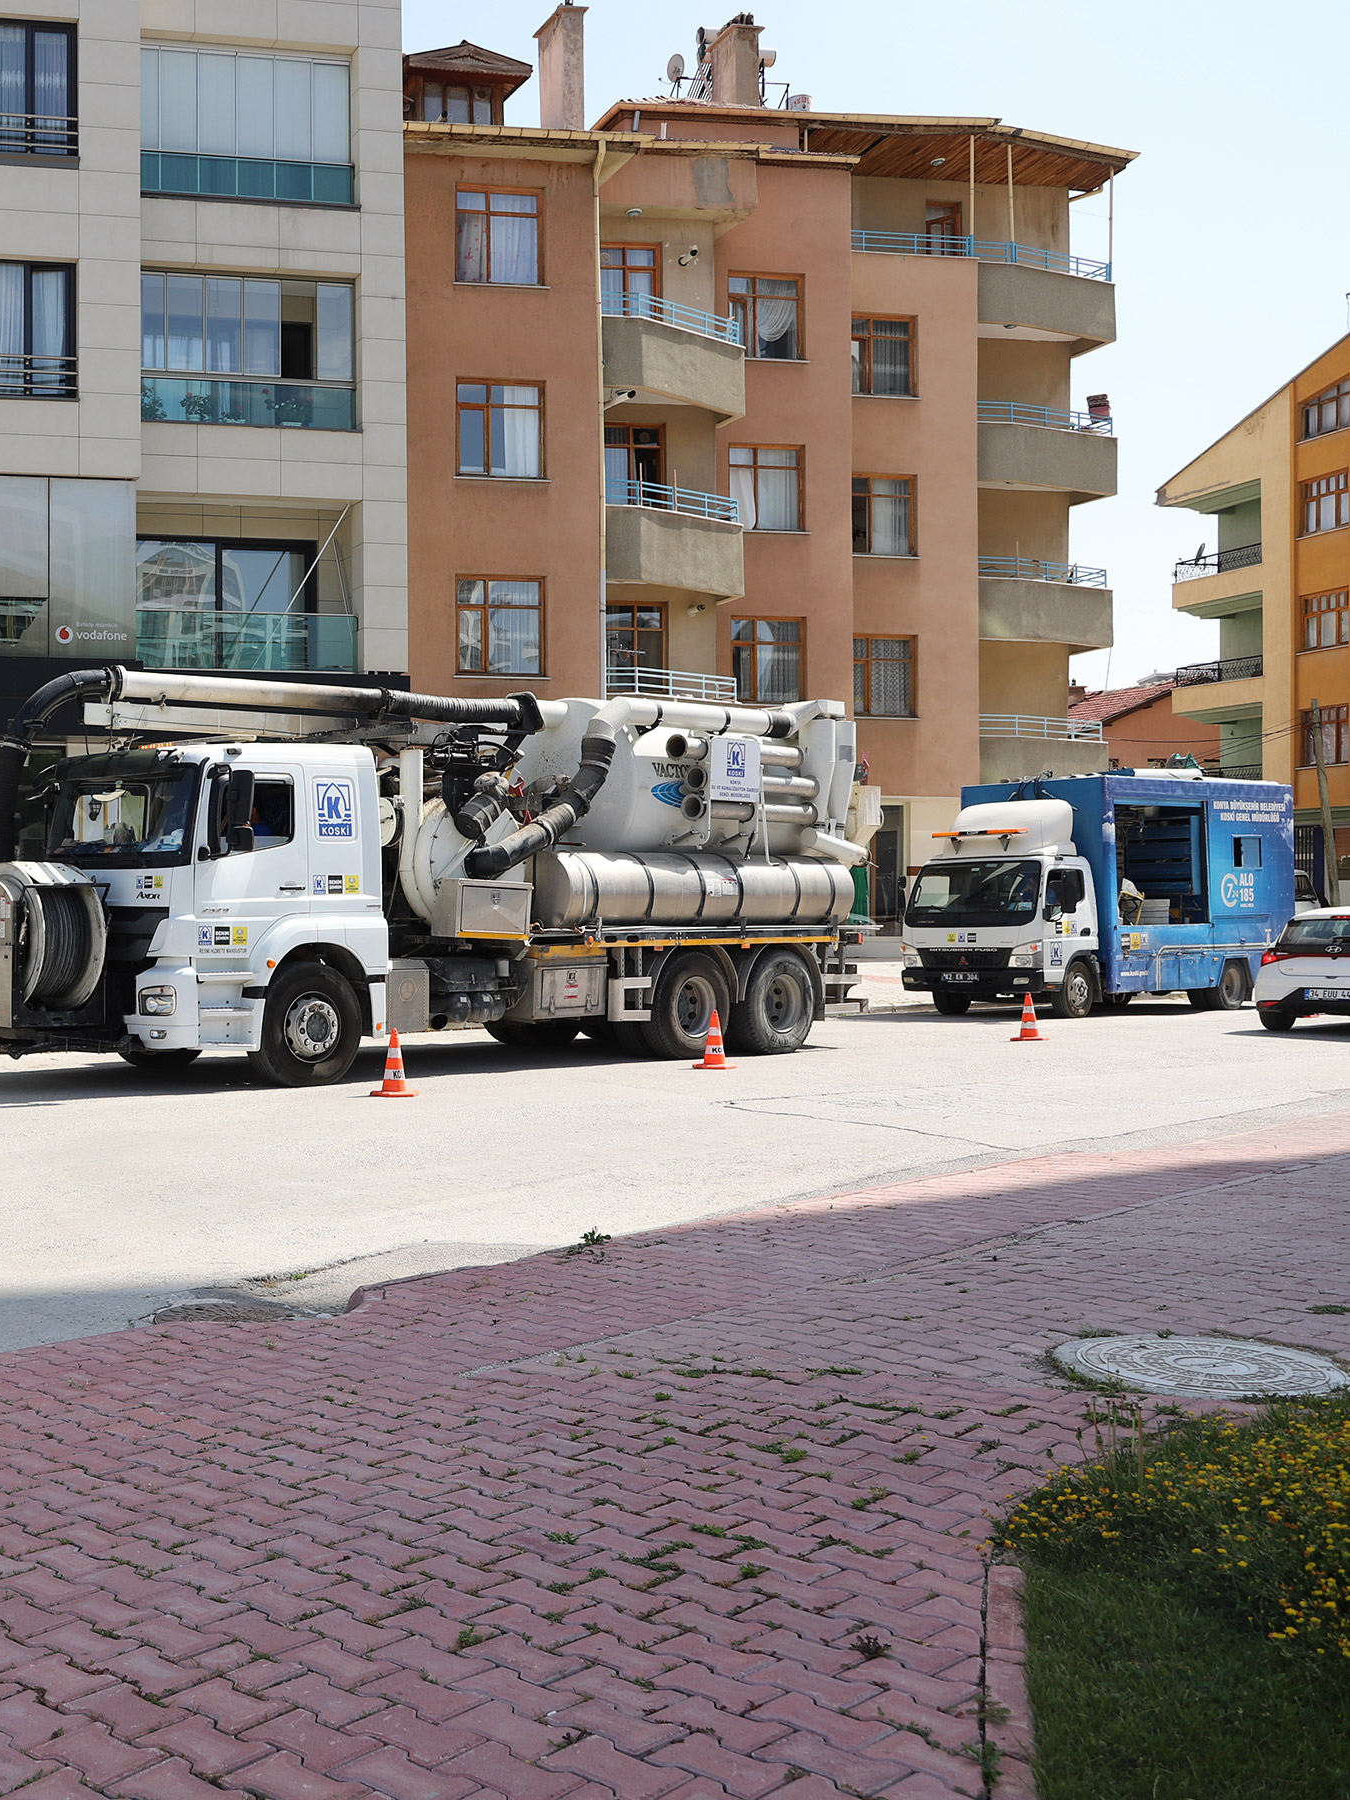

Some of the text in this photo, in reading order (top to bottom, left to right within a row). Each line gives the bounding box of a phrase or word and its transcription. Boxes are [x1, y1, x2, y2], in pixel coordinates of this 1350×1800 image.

[75, 630, 128, 641] vodafone
[321, 824, 350, 836] KOSKİ
[1239, 873, 1254, 886] ALO
[1240, 888, 1254, 902] 185
[1310, 990, 1319, 998] 34
[1322, 990, 1338, 998] EUU
